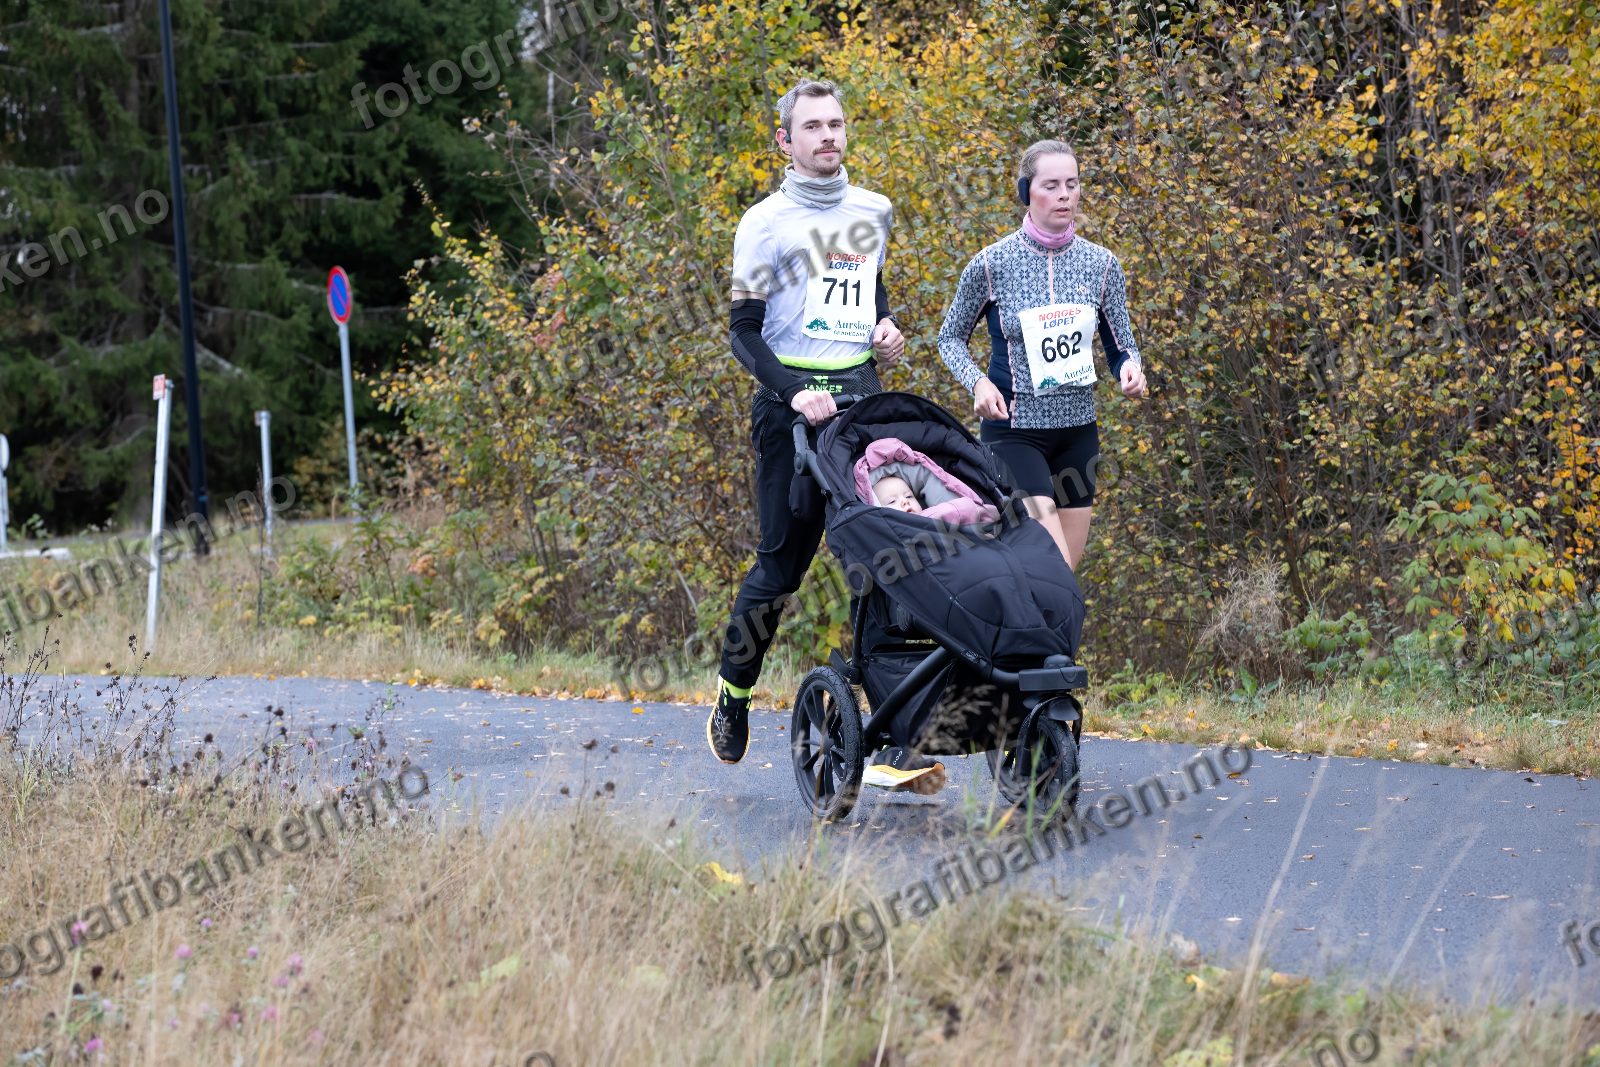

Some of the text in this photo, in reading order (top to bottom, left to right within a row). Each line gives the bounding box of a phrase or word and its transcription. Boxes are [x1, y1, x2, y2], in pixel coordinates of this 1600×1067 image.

[826, 252, 867, 263] NORGES
[828, 261, 860, 271] LØPET
[823, 277, 860, 306] 711
[1039, 308, 1082, 322] NORGES
[1043, 316, 1076, 329] LØPET
[1041, 331, 1082, 363] 662
